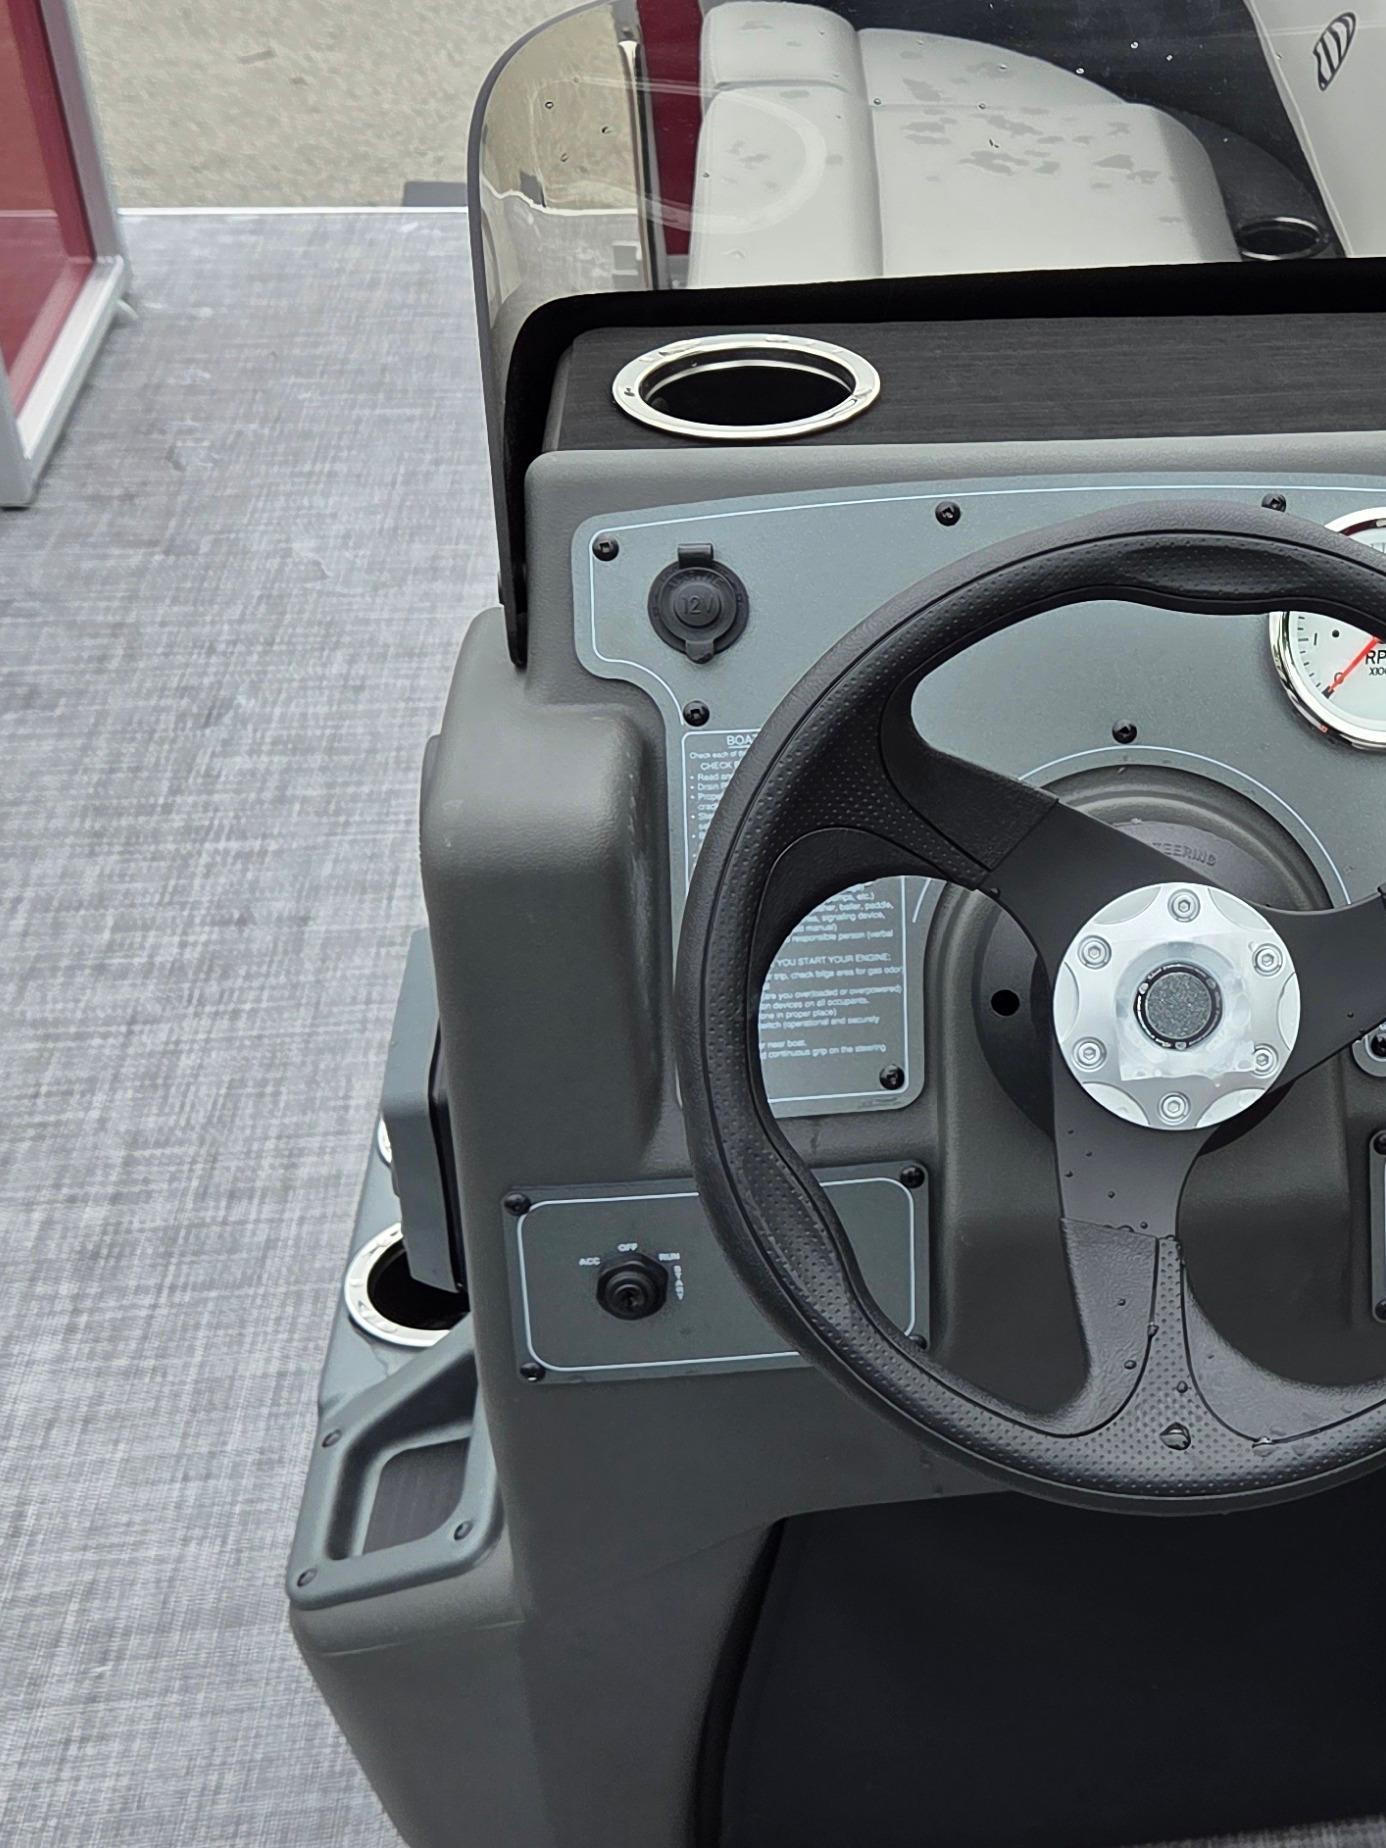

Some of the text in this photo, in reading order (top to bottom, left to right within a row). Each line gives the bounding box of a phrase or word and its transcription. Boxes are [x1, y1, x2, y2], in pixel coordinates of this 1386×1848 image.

[700, 761, 732, 771] CHECK
[775, 958, 797, 968] YOU
[798, 956, 826, 966] START
[827, 954, 854, 964] YOUR
[617, 1243, 638, 1252] OFF
[578, 1256, 601, 1266] ACC
[658, 1252, 681, 1261] RUN
